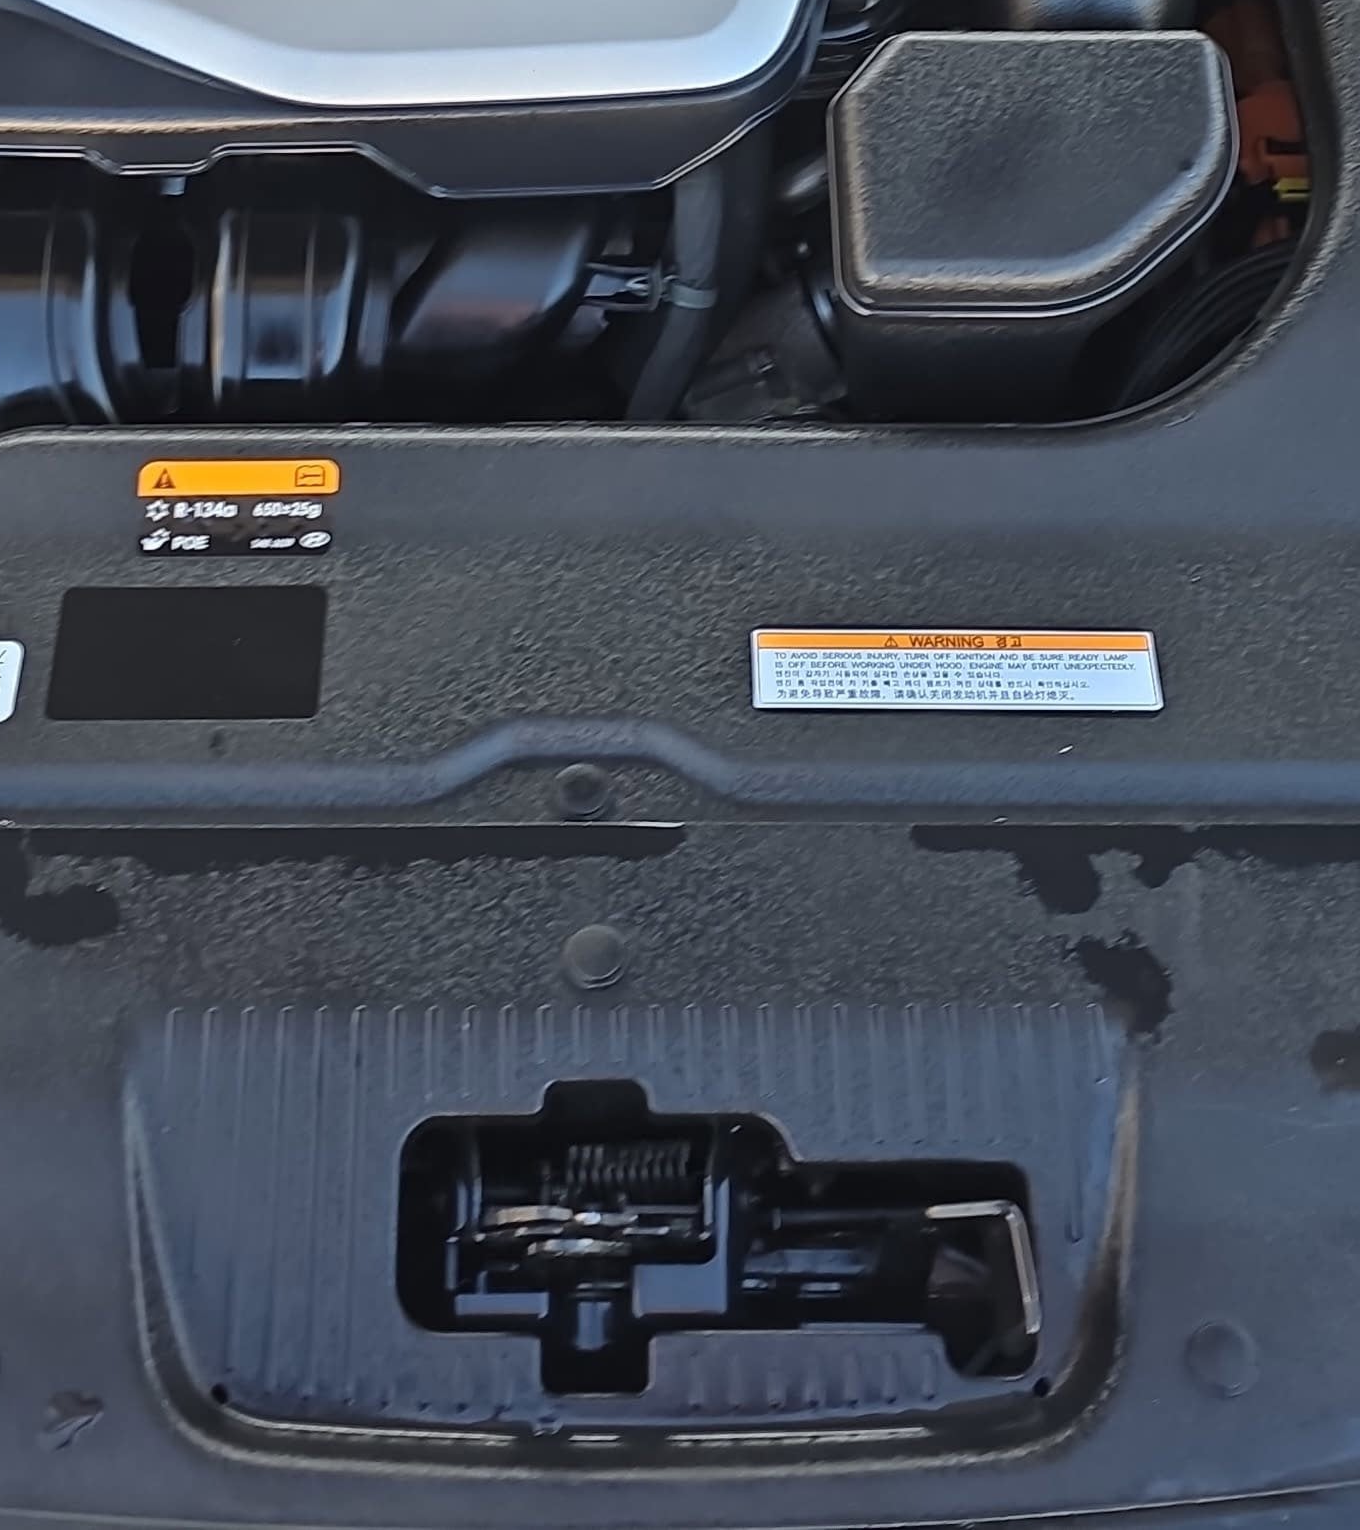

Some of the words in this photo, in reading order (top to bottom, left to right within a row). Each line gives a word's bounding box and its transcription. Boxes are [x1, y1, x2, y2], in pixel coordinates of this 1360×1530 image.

[909, 635, 985, 648] WARNING
[995, 636, 1023, 648] 경고
[774, 652, 787, 660] TO
[790, 652, 818, 660] AVOID
[822, 652, 862, 660] SERIOUS
[905, 652, 930, 661] TURN
[933, 652, 952, 661] OFF
[955, 653, 996, 661] IGNITION
[999, 653, 1018, 661] AND
[1022, 653, 1035, 661] BE
[1039, 653, 1065, 661] SURE
[1068, 653, 1099, 661] READY
[1103, 653, 1128, 661] LAMP
[775, 661, 784, 669] IS
[788, 661, 806, 669] OFF
[810, 661, 848, 669] BEFORE
[851, 661, 896, 669] WORKING
[899, 661, 932, 670] UNDER
[969, 662, 1004, 670] ENGINE
[1007, 662, 1026, 670] MAY
[1031, 662, 1060, 670] START
